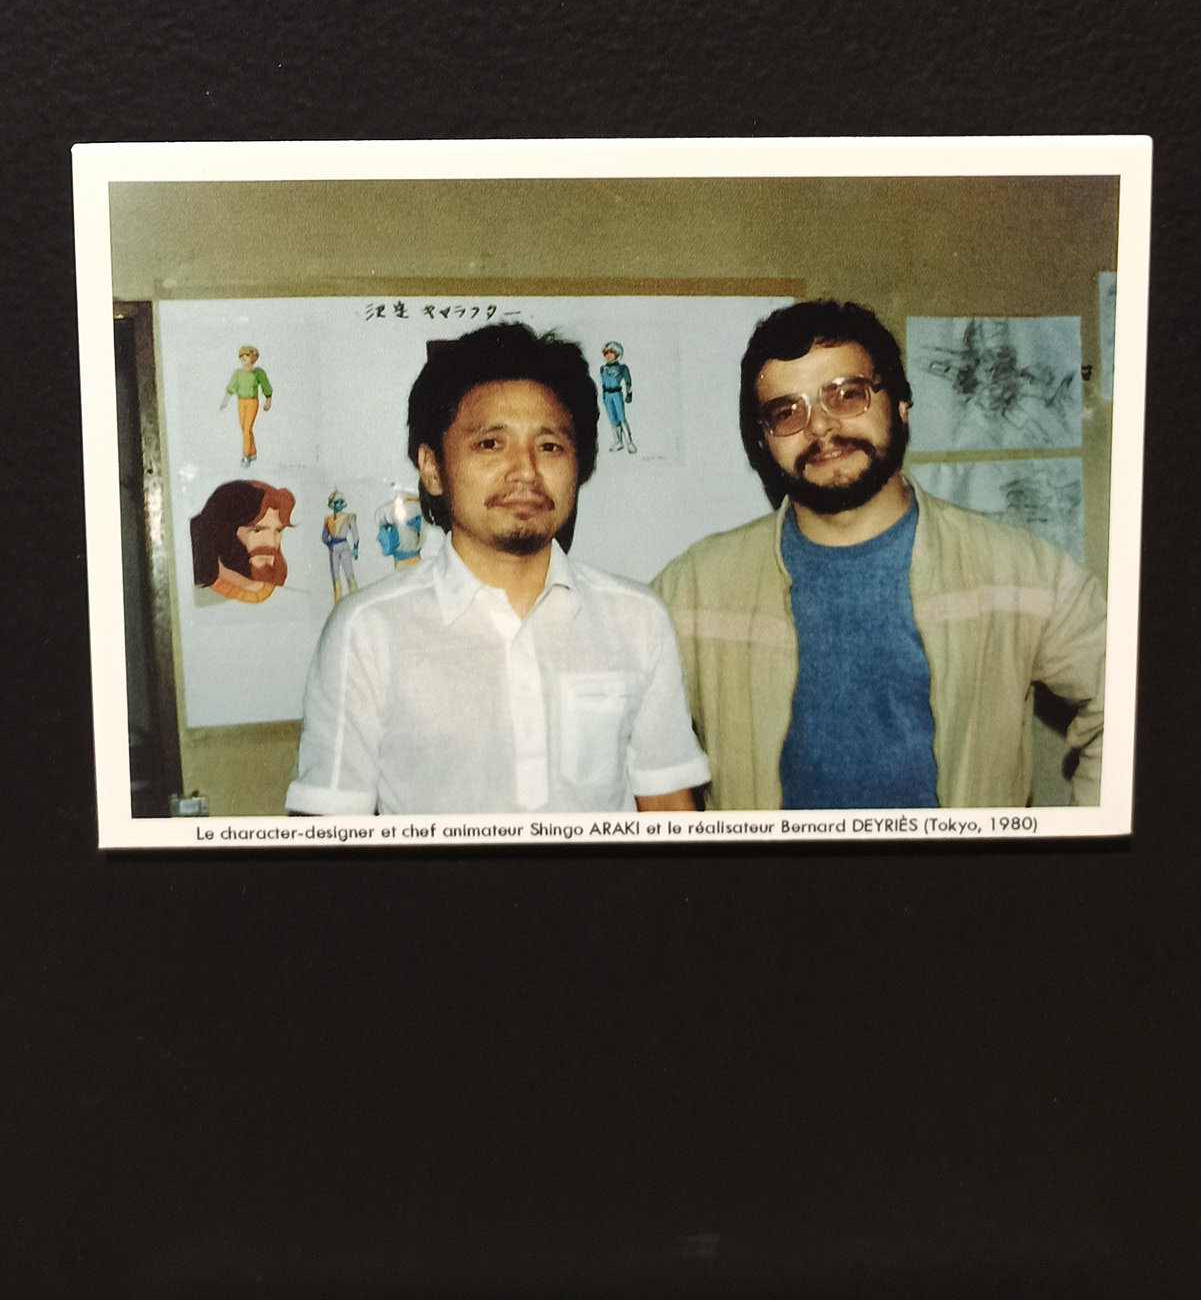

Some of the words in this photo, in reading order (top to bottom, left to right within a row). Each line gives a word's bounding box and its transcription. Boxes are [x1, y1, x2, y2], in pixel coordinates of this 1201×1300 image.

[196, 826, 214, 841] Le
[219, 825, 375, 842] character-designer
[380, 826, 396, 839] et
[401, 823, 436, 838] chef
[442, 823, 524, 838] animateur
[530, 821, 584, 840] Shingo
[590, 820, 640, 836] ARAKI
[646, 822, 662, 835] et
[667, 819, 682, 835] le
[687, 818, 775, 834] réalisateur
[781, 817, 846, 833] Bernard
[852, 814, 918, 833] DEYRIÈS
[923, 815, 982, 834] (Tokyo,
[989, 815, 1038, 833] 1980)
